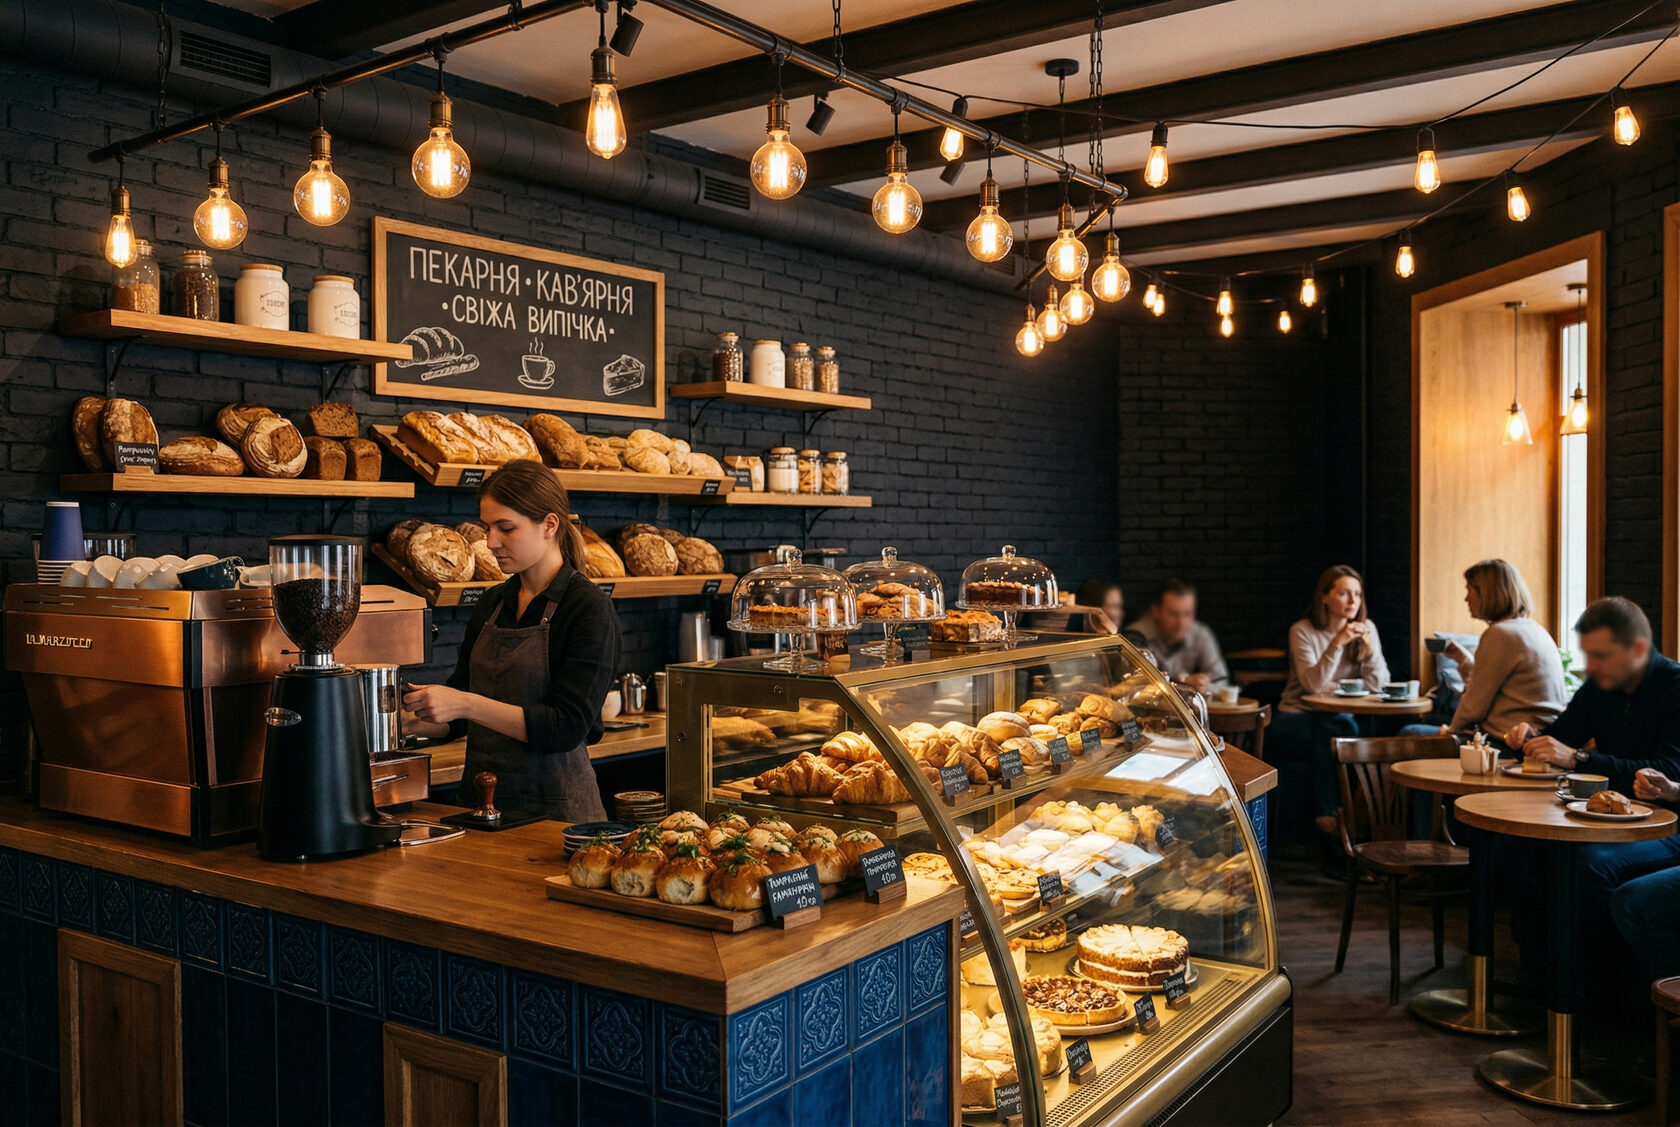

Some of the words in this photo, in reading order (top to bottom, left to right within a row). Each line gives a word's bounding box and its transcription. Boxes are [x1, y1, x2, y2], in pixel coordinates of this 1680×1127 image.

[409, 246, 520, 297] ПЕКАРНЯ
[536, 268, 634, 316] КАВ'ЯРНЯ
[451, 294, 517, 330] СВІЖА
[527, 305, 608, 343] ВИПІЧКА
